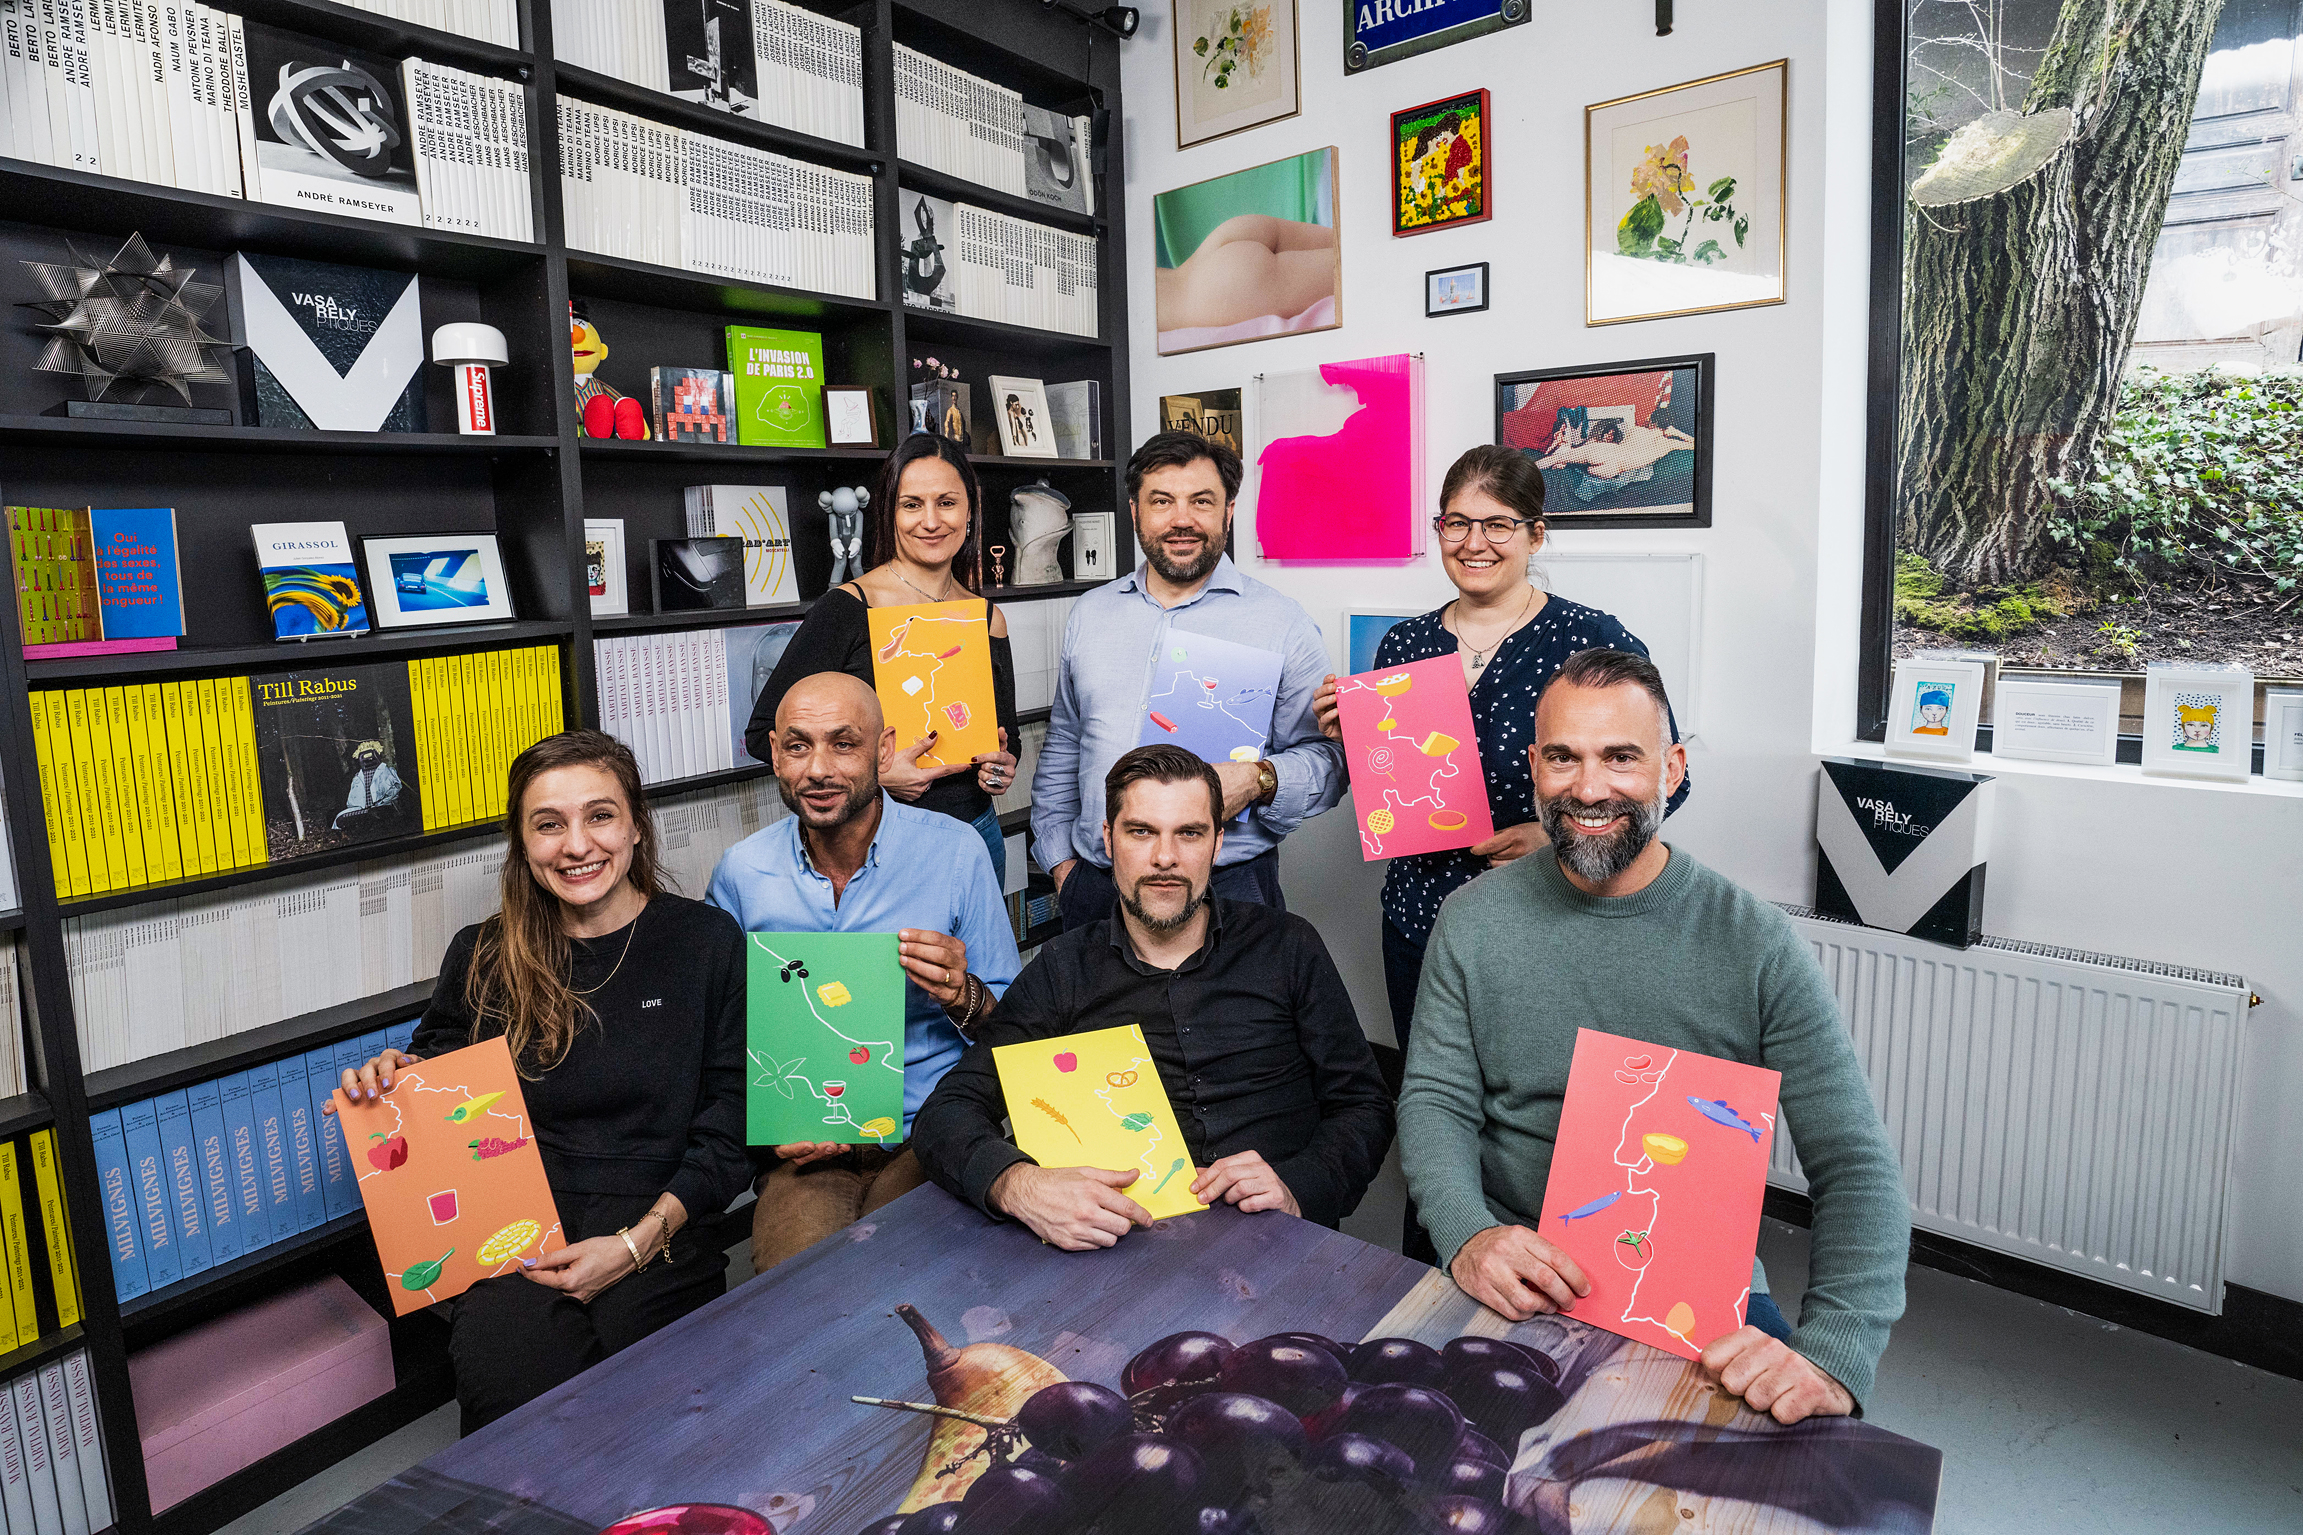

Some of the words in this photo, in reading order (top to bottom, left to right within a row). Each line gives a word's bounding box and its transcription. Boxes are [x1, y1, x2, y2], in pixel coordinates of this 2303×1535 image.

[6, 20, 20, 57] BERTO
[148, 4, 161, 47] AFONSO
[167, 7, 178, 37] GABO
[185, 9, 197, 56] PEVSNER
[200, 17, 209, 51] TEANA
[217, 23, 226, 53] BALLY
[26, 25, 40, 62] BERTO
[46, 31, 59, 68] BERTO
[170, 42, 181, 72] NAUM
[203, 53, 212, 64] DI
[232, 27, 245, 67] CASTEL
[62, 45, 76, 84] ANDRE
[77, 49, 90, 88] ANDRE
[152, 52, 164, 83] NADIR
[188, 59, 202, 102] ANTOINE
[204, 67, 216, 106] MARINO
[220, 57, 232, 112] THEODORE
[237, 73, 249, 110] MOSHE
[415, 68, 424, 121] RAMSEYER
[422, 72, 433, 123] RAMSEYER
[432, 75, 443, 125] RAMSEYER
[442, 77, 452, 127] RAMSEYER
[451, 78, 462, 128] RAMSEYER
[460, 80, 470, 131] RAMSEYER
[469, 84, 480, 140] AESCHBACHER
[479, 86, 490, 142] AESCHBACHER
[489, 88, 499, 144] AESCHBACHER
[498, 88, 508, 144] AESCHBACHER
[509, 92, 519, 148] AESCHBACHER
[516, 94, 526, 149] AESCHBACHER
[76, 154, 82, 162] 2
[418, 124, 427, 157] ANDRE
[428, 127, 437, 159] ANDRE
[437, 129, 447, 161] ANDRE
[447, 131, 456, 162] ANDRE
[456, 132, 465, 164] ANDRE
[465, 135, 474, 166] ANDRE
[485, 146, 493, 167] HANS
[493, 148, 501, 169] HANS
[585, 140, 591, 149] DI
[90, 157, 96, 165] 2
[297, 190, 333, 203] ANDRÉ
[339, 197, 394, 213] RAMSEYER
[291, 292, 337, 310] VASA
[316, 305, 357, 320] RELY
[747, 363, 760, 376] DE
[763, 364, 795, 378] PARIS
[797, 365, 814, 379] 2.0
[749, 347, 810, 365] L'INVASION
[469, 371, 486, 427] Supreme
[1168, 414, 1233, 436] VENDU
[96, 546, 103, 556] à
[107, 544, 157, 558] l'égalité
[114, 532, 137, 543] Oui
[272, 540, 338, 550] GIRASSOL
[96, 558, 118, 568] des
[122, 559, 161, 568] sexes,
[105, 571, 133, 580] tous
[137, 570, 153, 580] de
[103, 583, 114, 593] la
[118, 583, 158, 592] même
[258, 681, 294, 700] Till
[298, 678, 357, 696] Rabus
[33, 712, 41, 730] Rabus
[1856, 797, 1895, 814] VASA
[1875, 807, 1912, 825] RELY
[642, 999, 662, 1008] LOVE
[39, 1154, 47, 1168] Rabus
[264, 1117, 288, 1205] MILVIGNES
[292, 1108, 315, 1195] MILVIGNES
[204, 1135, 231, 1227] MILVIGNES
[234, 1126, 260, 1216] MILVIGNES
[140, 1155, 168, 1250] MILVIGNES
[172, 1145, 200, 1238] MILVIGNES
[104, 1167, 136, 1262] MILVIGNES
[46, 1368, 62, 1411] RAYSSE
[70, 1355, 88, 1399] RAYSSE
[21, 1379, 37, 1422] RAYSSE
[53, 1410, 71, 1460] MARTIAL
[77, 1398, 94, 1447] MARTIAL
[3, 1434, 21, 1485] MARTIAL
[28, 1421, 46, 1472] MARTIAL
